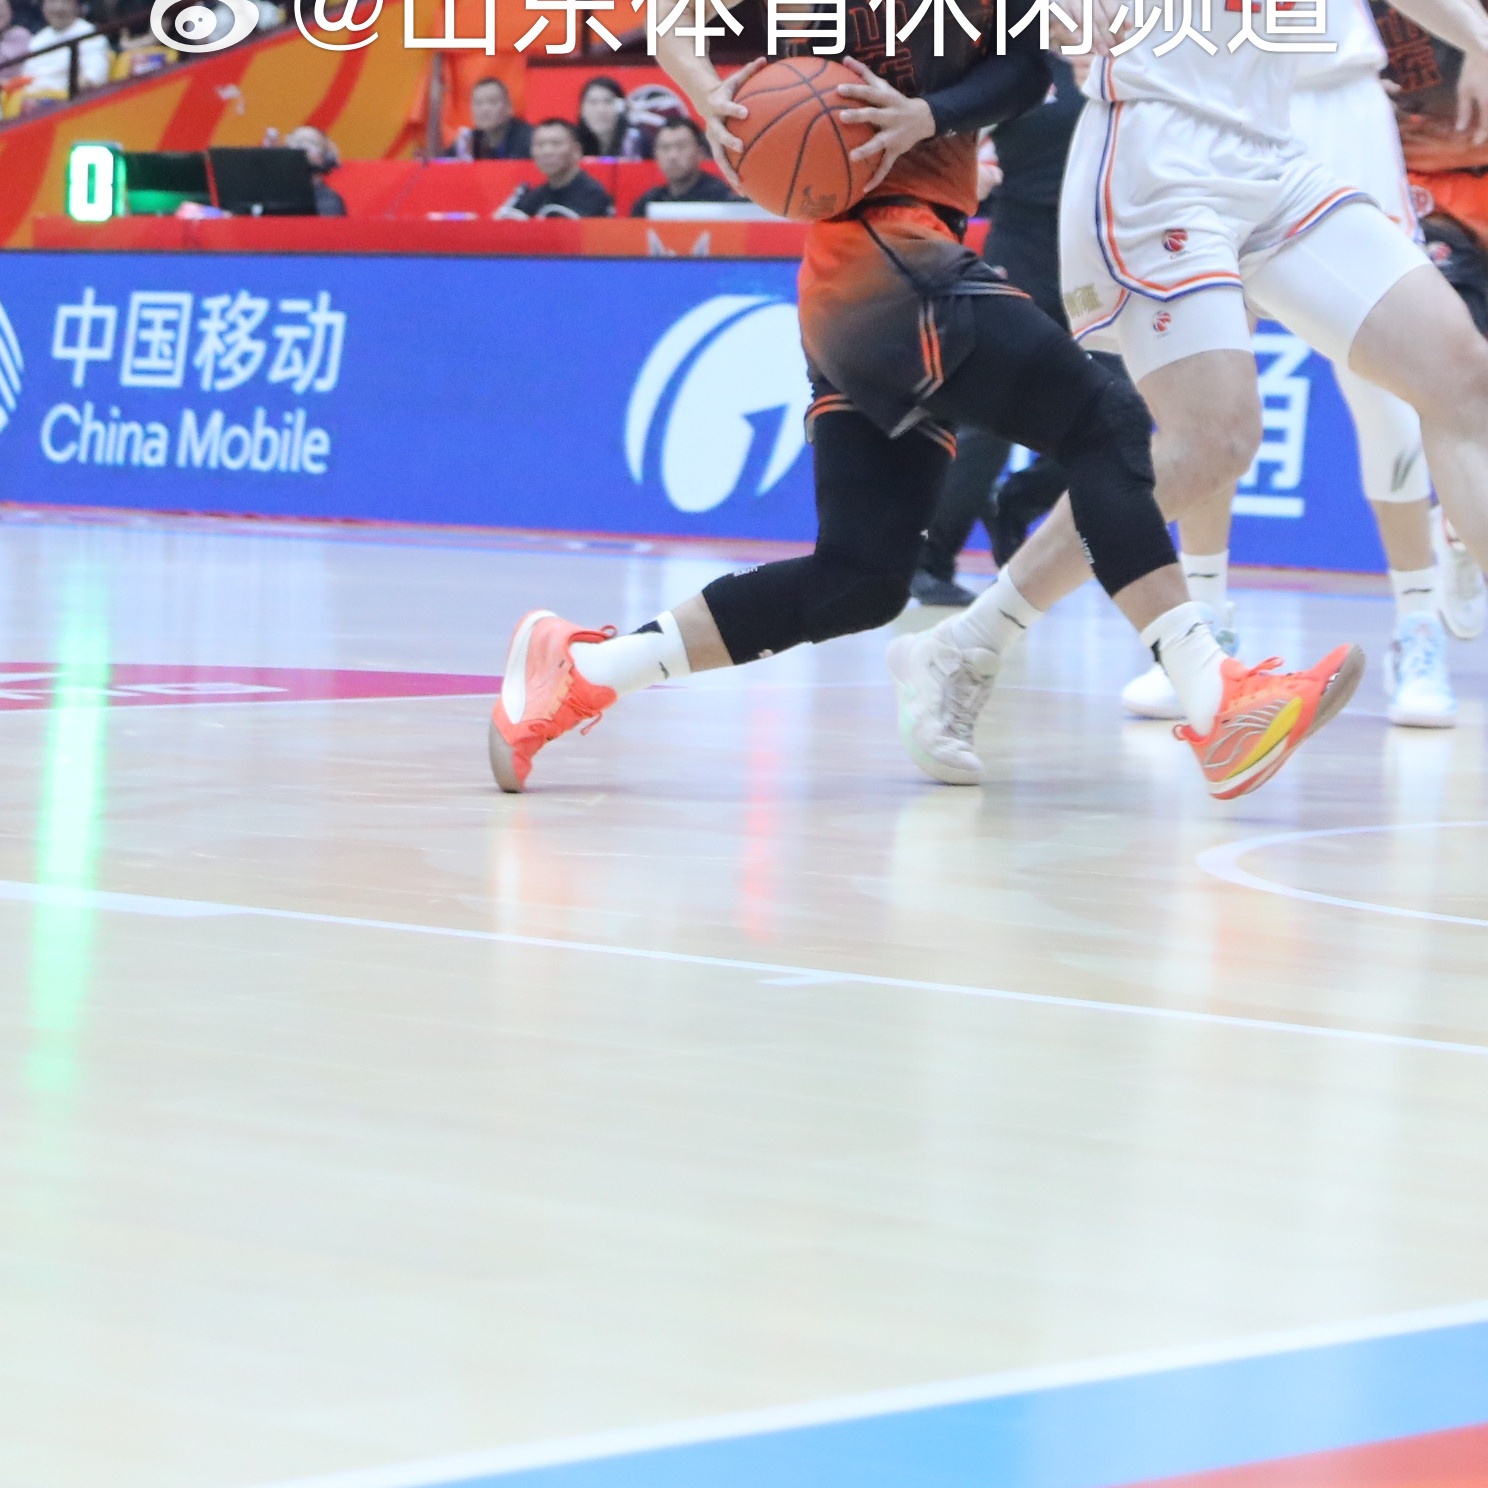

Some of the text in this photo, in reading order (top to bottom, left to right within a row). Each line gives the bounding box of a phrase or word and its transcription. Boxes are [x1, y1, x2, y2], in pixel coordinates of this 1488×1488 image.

[50, 286, 347, 395] 中国移动
[40, 402, 331, 475] China Mobile
